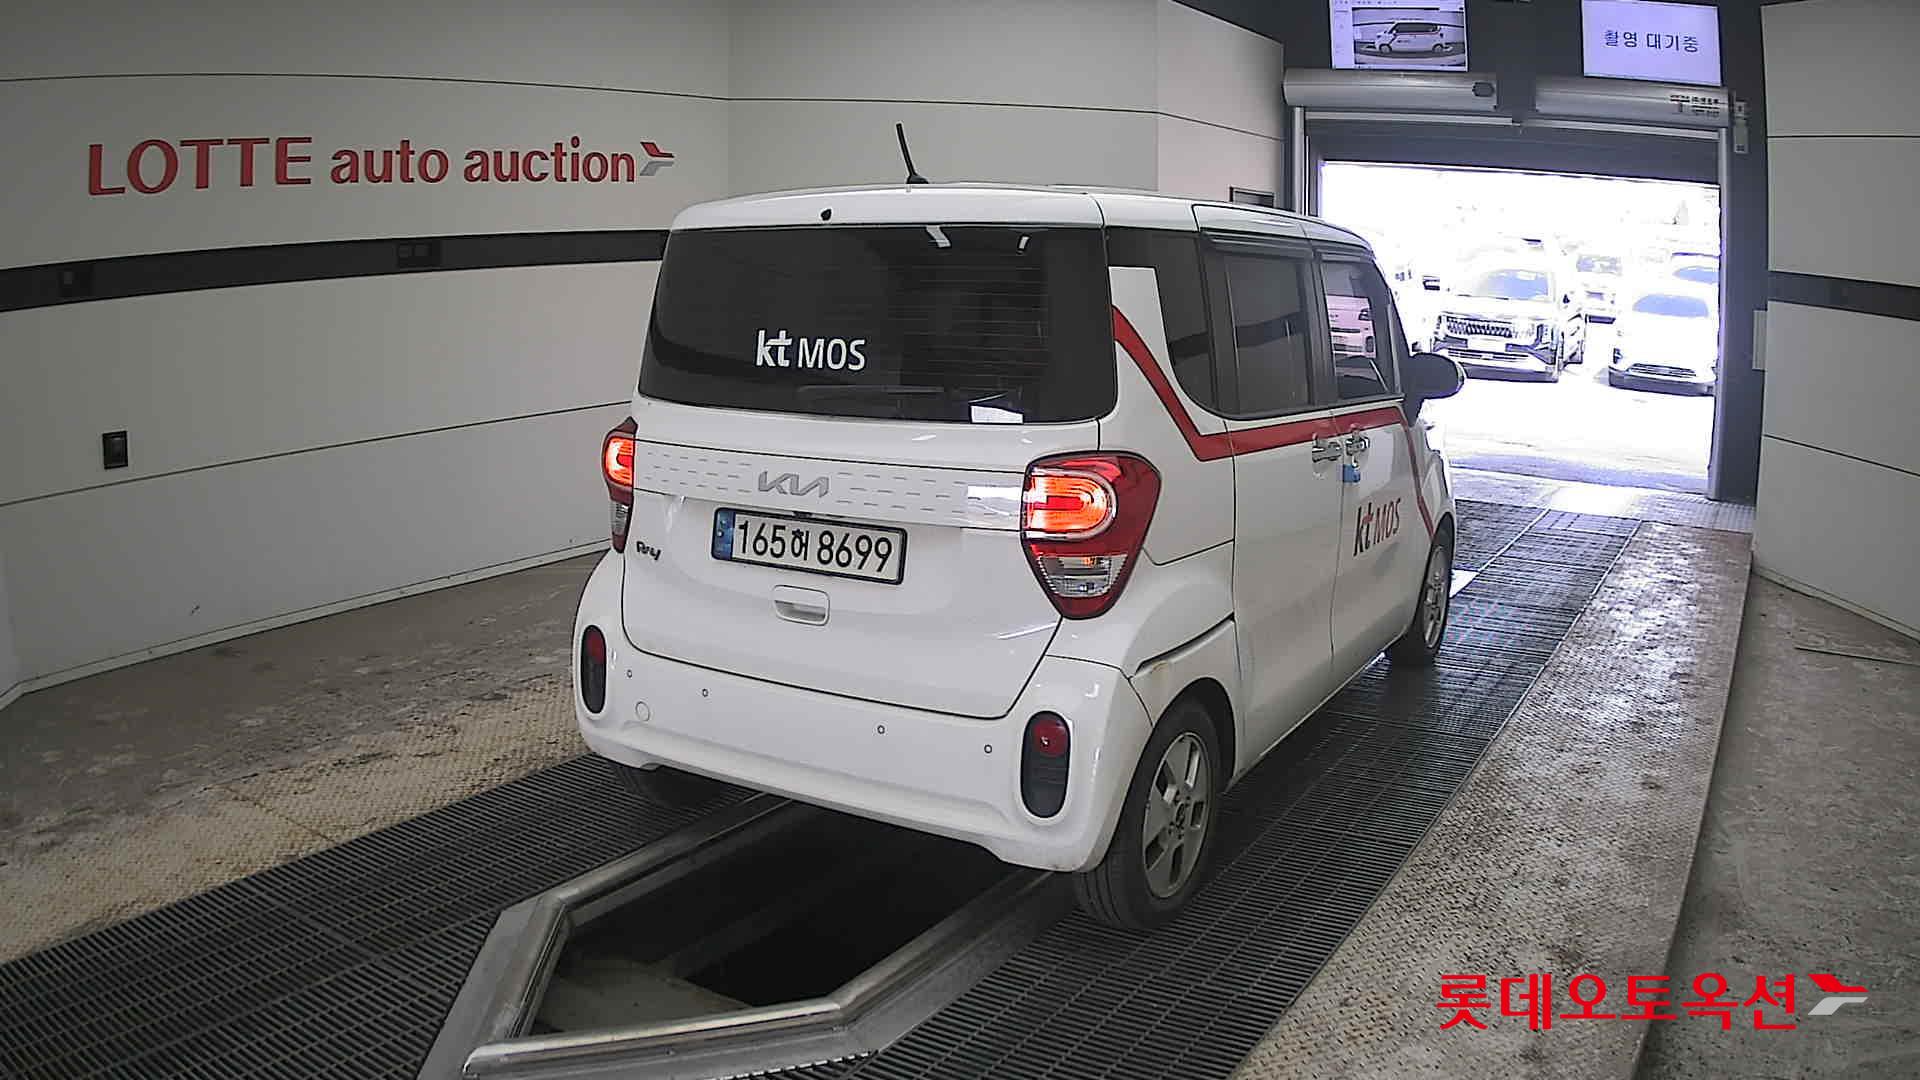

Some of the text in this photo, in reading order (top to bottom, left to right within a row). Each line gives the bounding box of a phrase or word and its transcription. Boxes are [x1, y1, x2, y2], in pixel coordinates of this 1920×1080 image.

[1604, 30, 1698, 53] 촬영 대기중
[88, 136, 636, 196] LOTTE auto auction
[756, 330, 866, 370] kt MOS
[1373, 498, 1402, 545] MOS
[738, 519, 893, 573] 165허 8699
